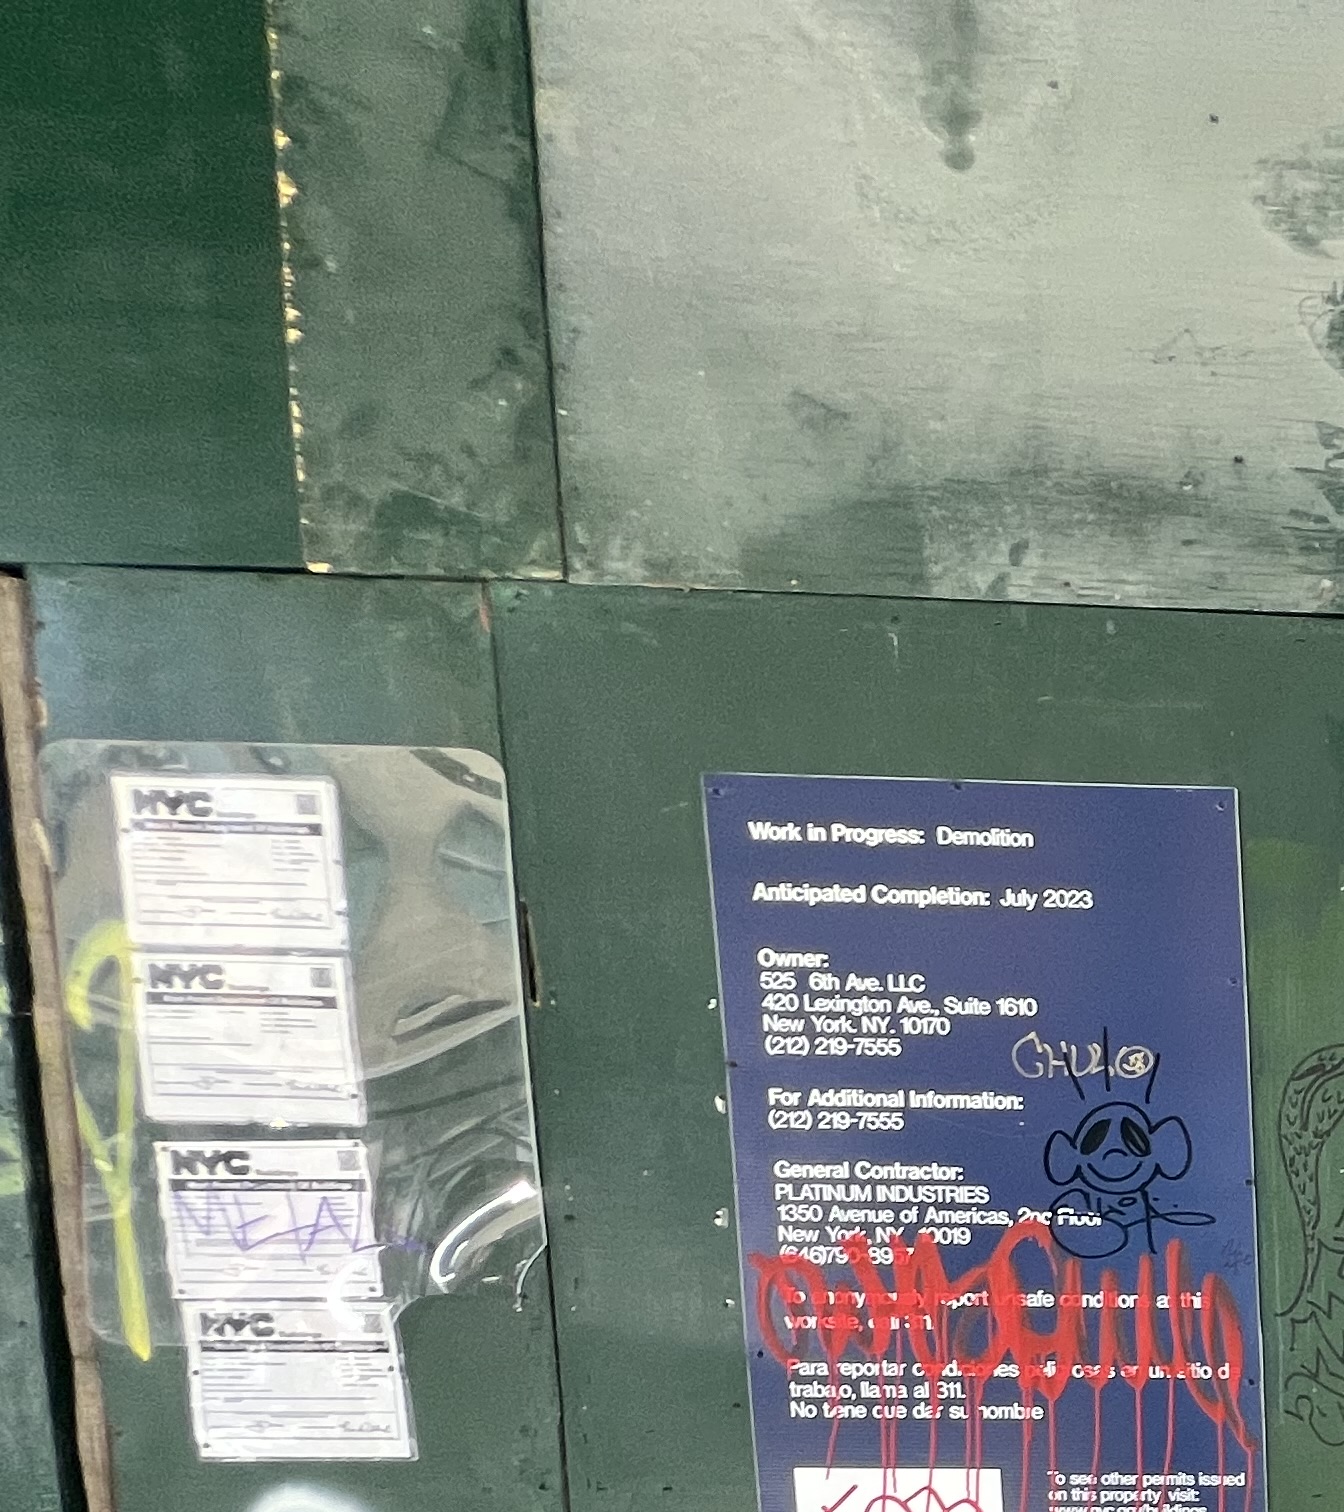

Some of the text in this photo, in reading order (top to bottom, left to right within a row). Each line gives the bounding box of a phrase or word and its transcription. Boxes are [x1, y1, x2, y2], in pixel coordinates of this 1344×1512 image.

[746, 821, 1035, 848] Work in Progress: Demolition
[752, 882, 1094, 911] Anticipated Completion: July 2023
[757, 947, 830, 968] Owner:
[147, 963, 226, 990] NYC
[759, 971, 926, 993] 525 6th Ave. LLC
[761, 993, 799, 1012] 420
[803, 993, 892, 1016] Lexington
[943, 996, 992, 1016] Suite
[995, 998, 1039, 1017] 1610
[762, 1014, 805, 1033] New
[900, 1016, 951, 1035] 10170
[764, 1035, 902, 1057] (212) 219-7555
[767, 1087, 1025, 1110] For Additional Information:
[767, 1109, 905, 1131] (212) 219-7555
[169, 1150, 251, 1175] NYC
[773, 1159, 964, 1181] General Contractor:
[775, 1183, 990, 1204] PLATINUM INDUSTRIES
[777, 1204, 823, 1222] 1350
[828, 1205, 895, 1224] Avenue
[899, 1206, 919, 1224] of
[923, 1206, 1014, 1227] Americas,
[777, 1226, 820, 1243] New
[912, 1381, 930, 1399] al
[789, 1401, 818, 1419] No
